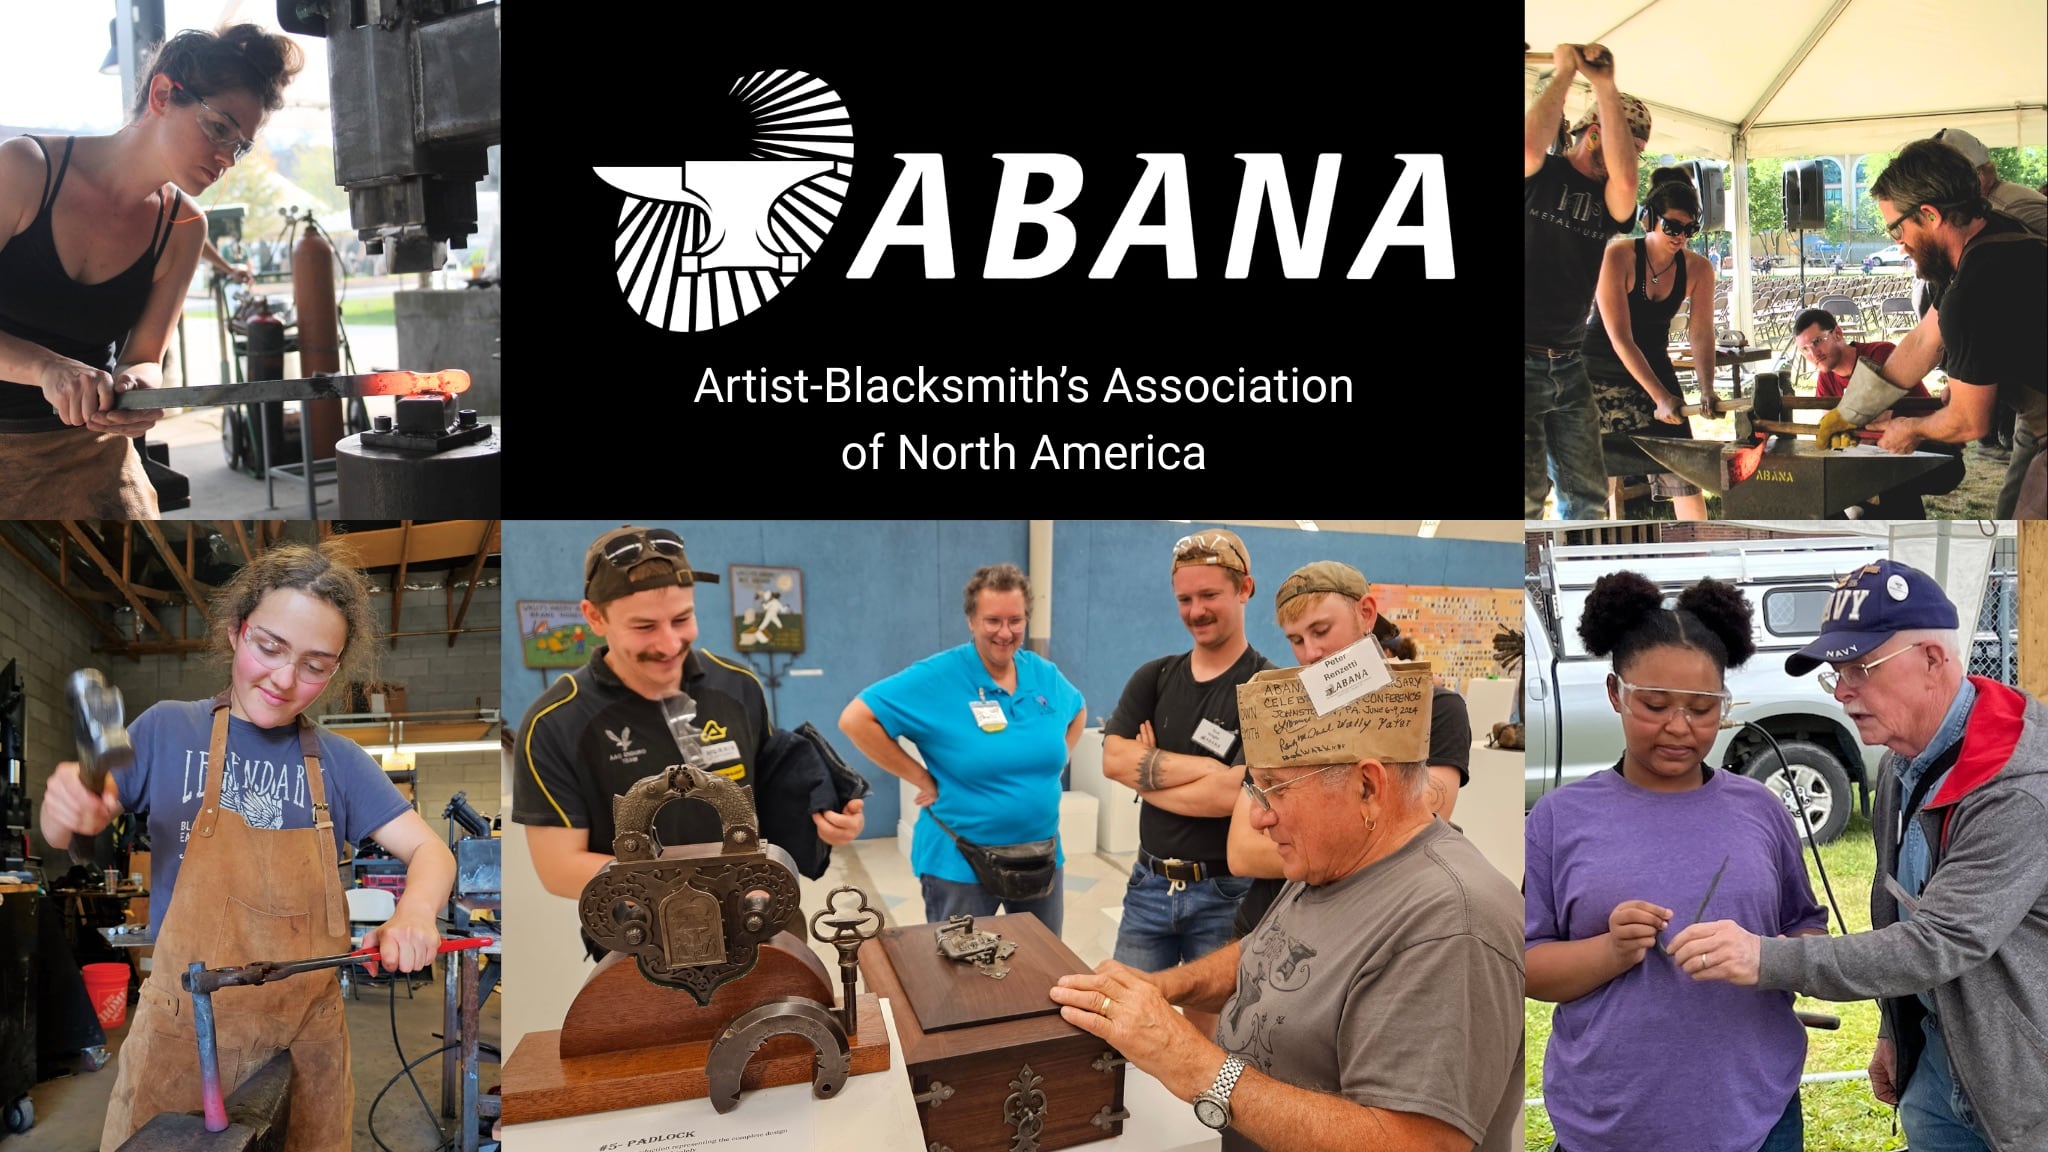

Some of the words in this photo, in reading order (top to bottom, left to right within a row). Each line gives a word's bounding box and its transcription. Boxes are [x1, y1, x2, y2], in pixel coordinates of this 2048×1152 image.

[1756, 470, 1793, 482] ABANA
[1821, 589, 1870, 622] AVY
[1826, 644, 1858, 658] NAVY
[1324, 653, 1347, 669] Peter
[1323, 660, 1358, 682] Renzetti
[1335, 669, 1369, 691] ABANA
[1363, 705, 1383, 715] JUNE
[1337, 717, 1372, 734] Wally
[627, 1131, 695, 1148] PADLOCK
[671, 1139, 716, 1151] representing
[731, 1132, 764, 1141] complete
[765, 1129, 788, 1137] design
